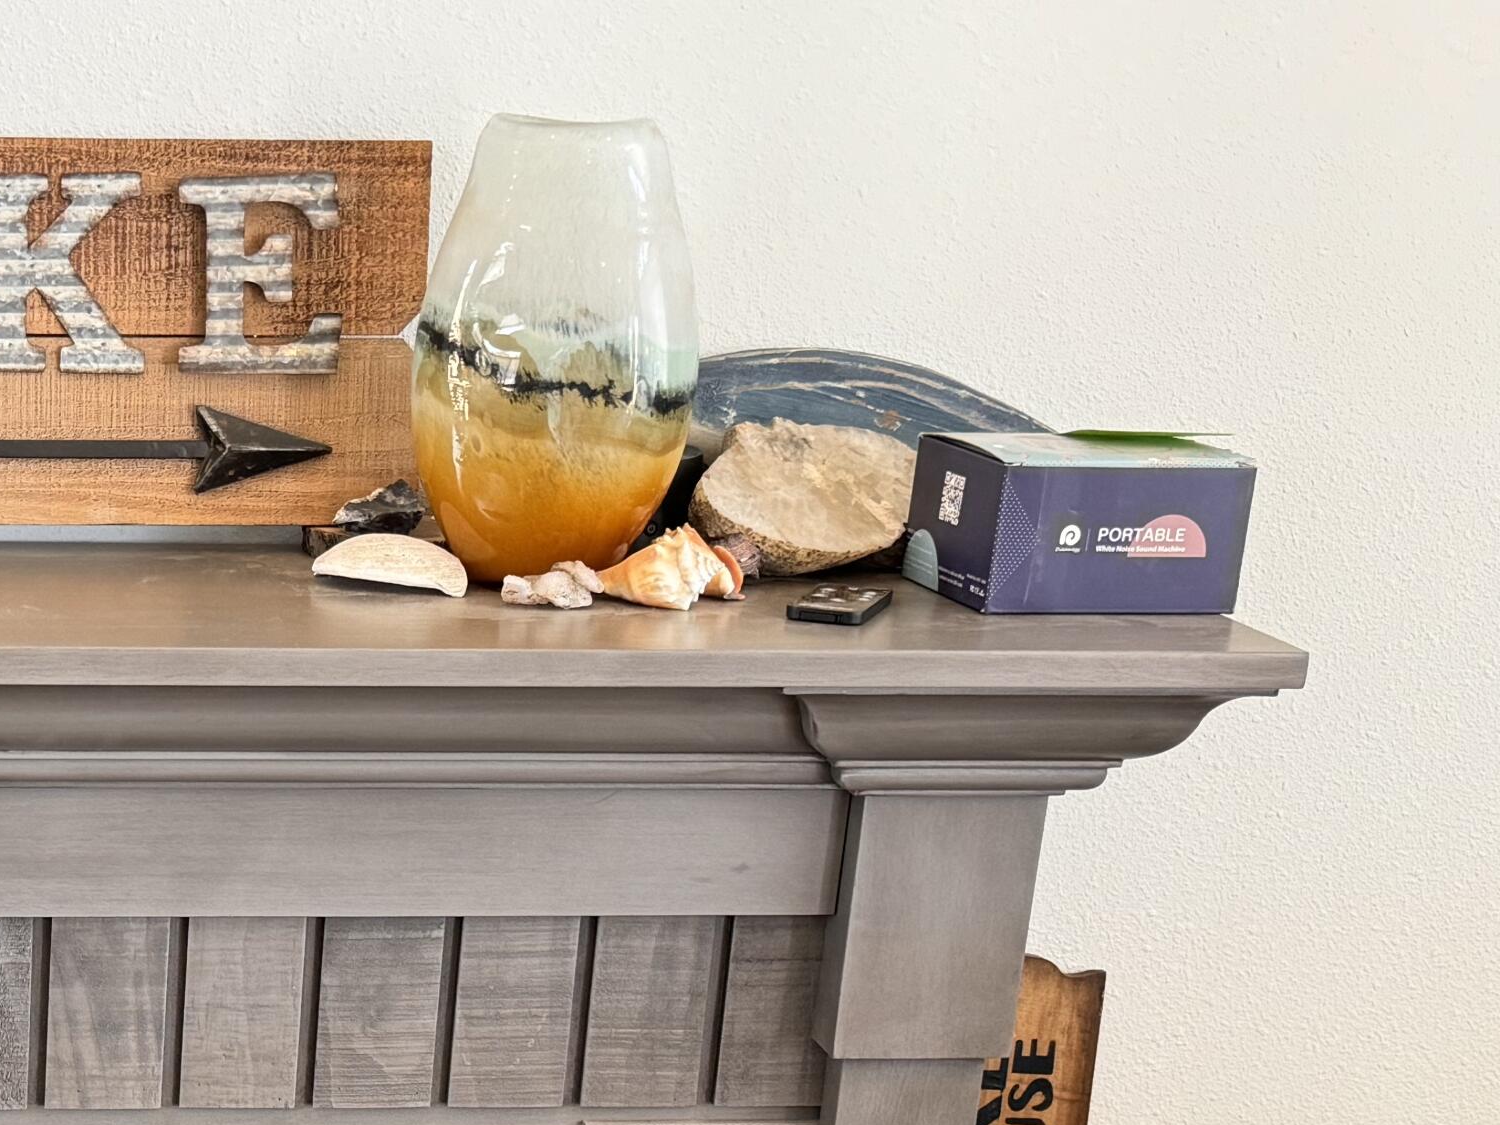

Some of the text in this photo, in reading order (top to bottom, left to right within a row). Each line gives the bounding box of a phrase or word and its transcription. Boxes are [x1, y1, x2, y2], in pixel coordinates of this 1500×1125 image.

[1097, 527, 1187, 542] PORTABLE
[1096, 545, 1186, 553] White Noise Sound Machine
